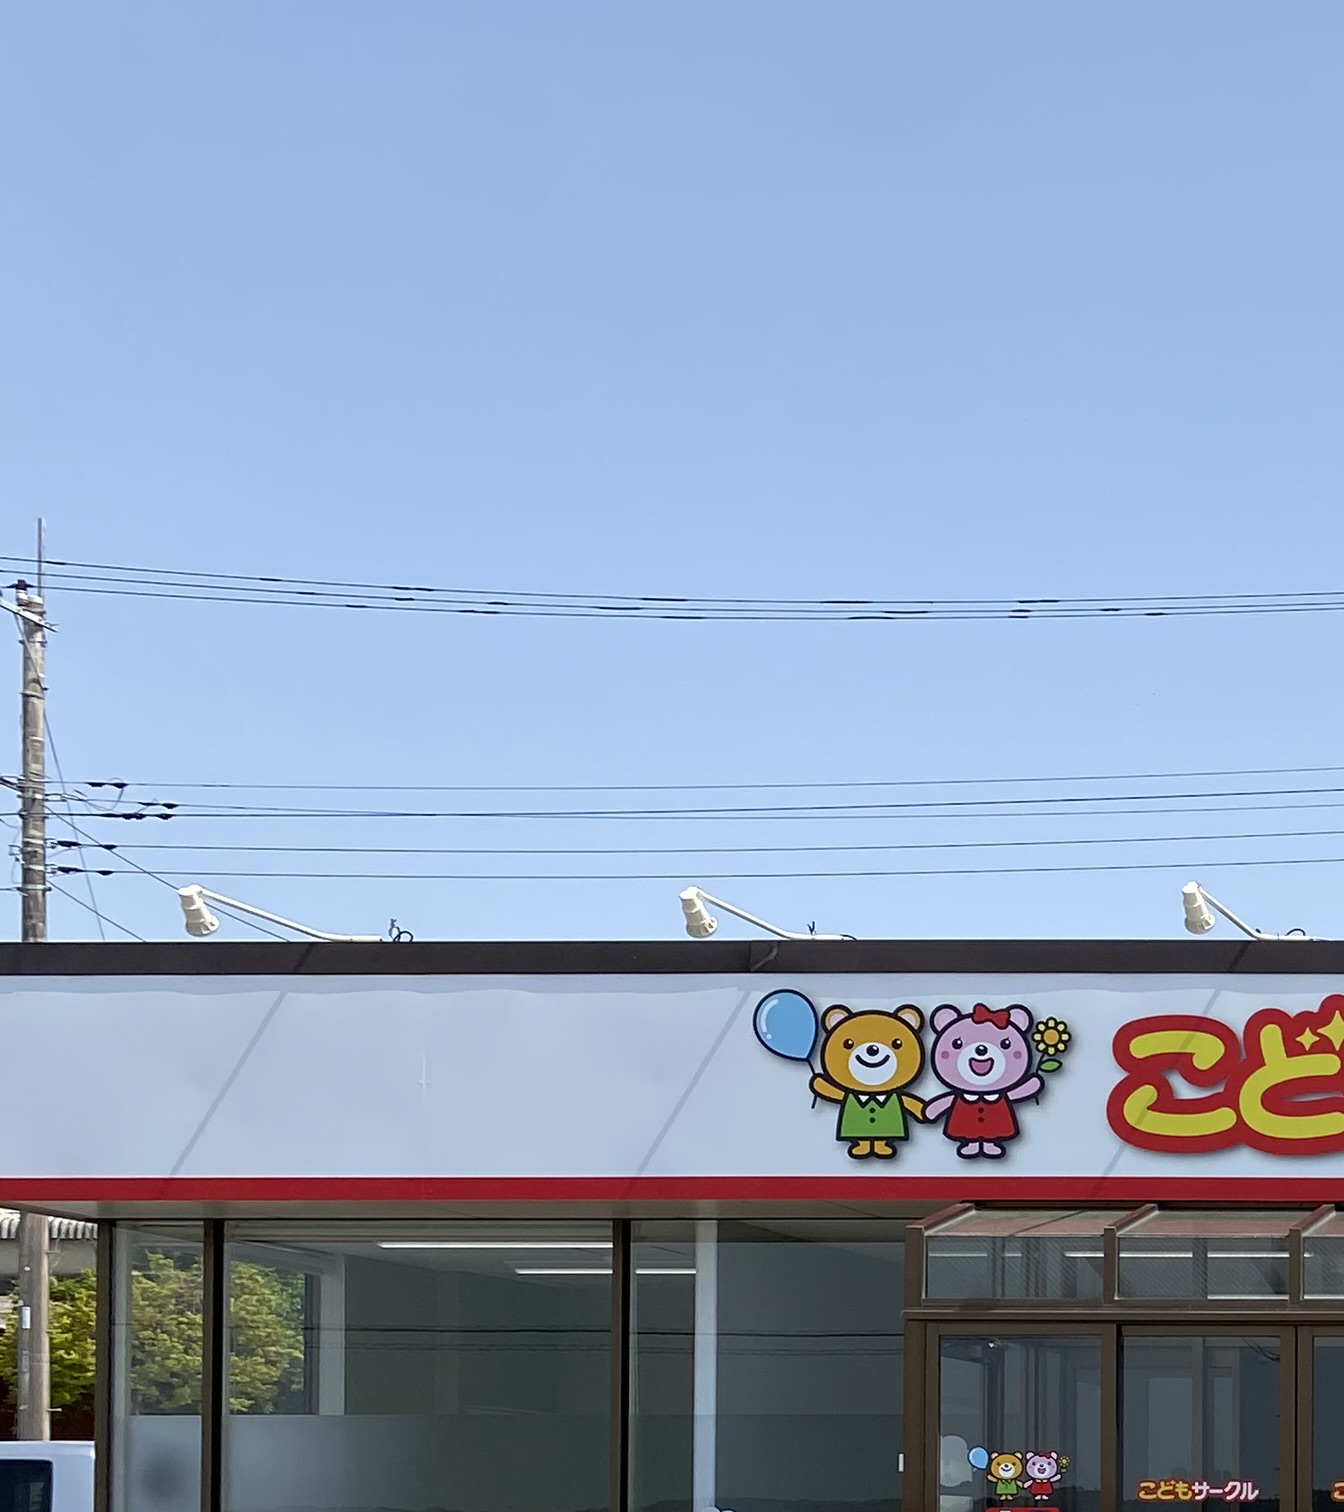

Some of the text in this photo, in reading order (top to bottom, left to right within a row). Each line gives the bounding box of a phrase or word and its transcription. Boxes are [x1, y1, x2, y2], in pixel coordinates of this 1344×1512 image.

[1138, 1479, 1259, 1501] こどもサークル
